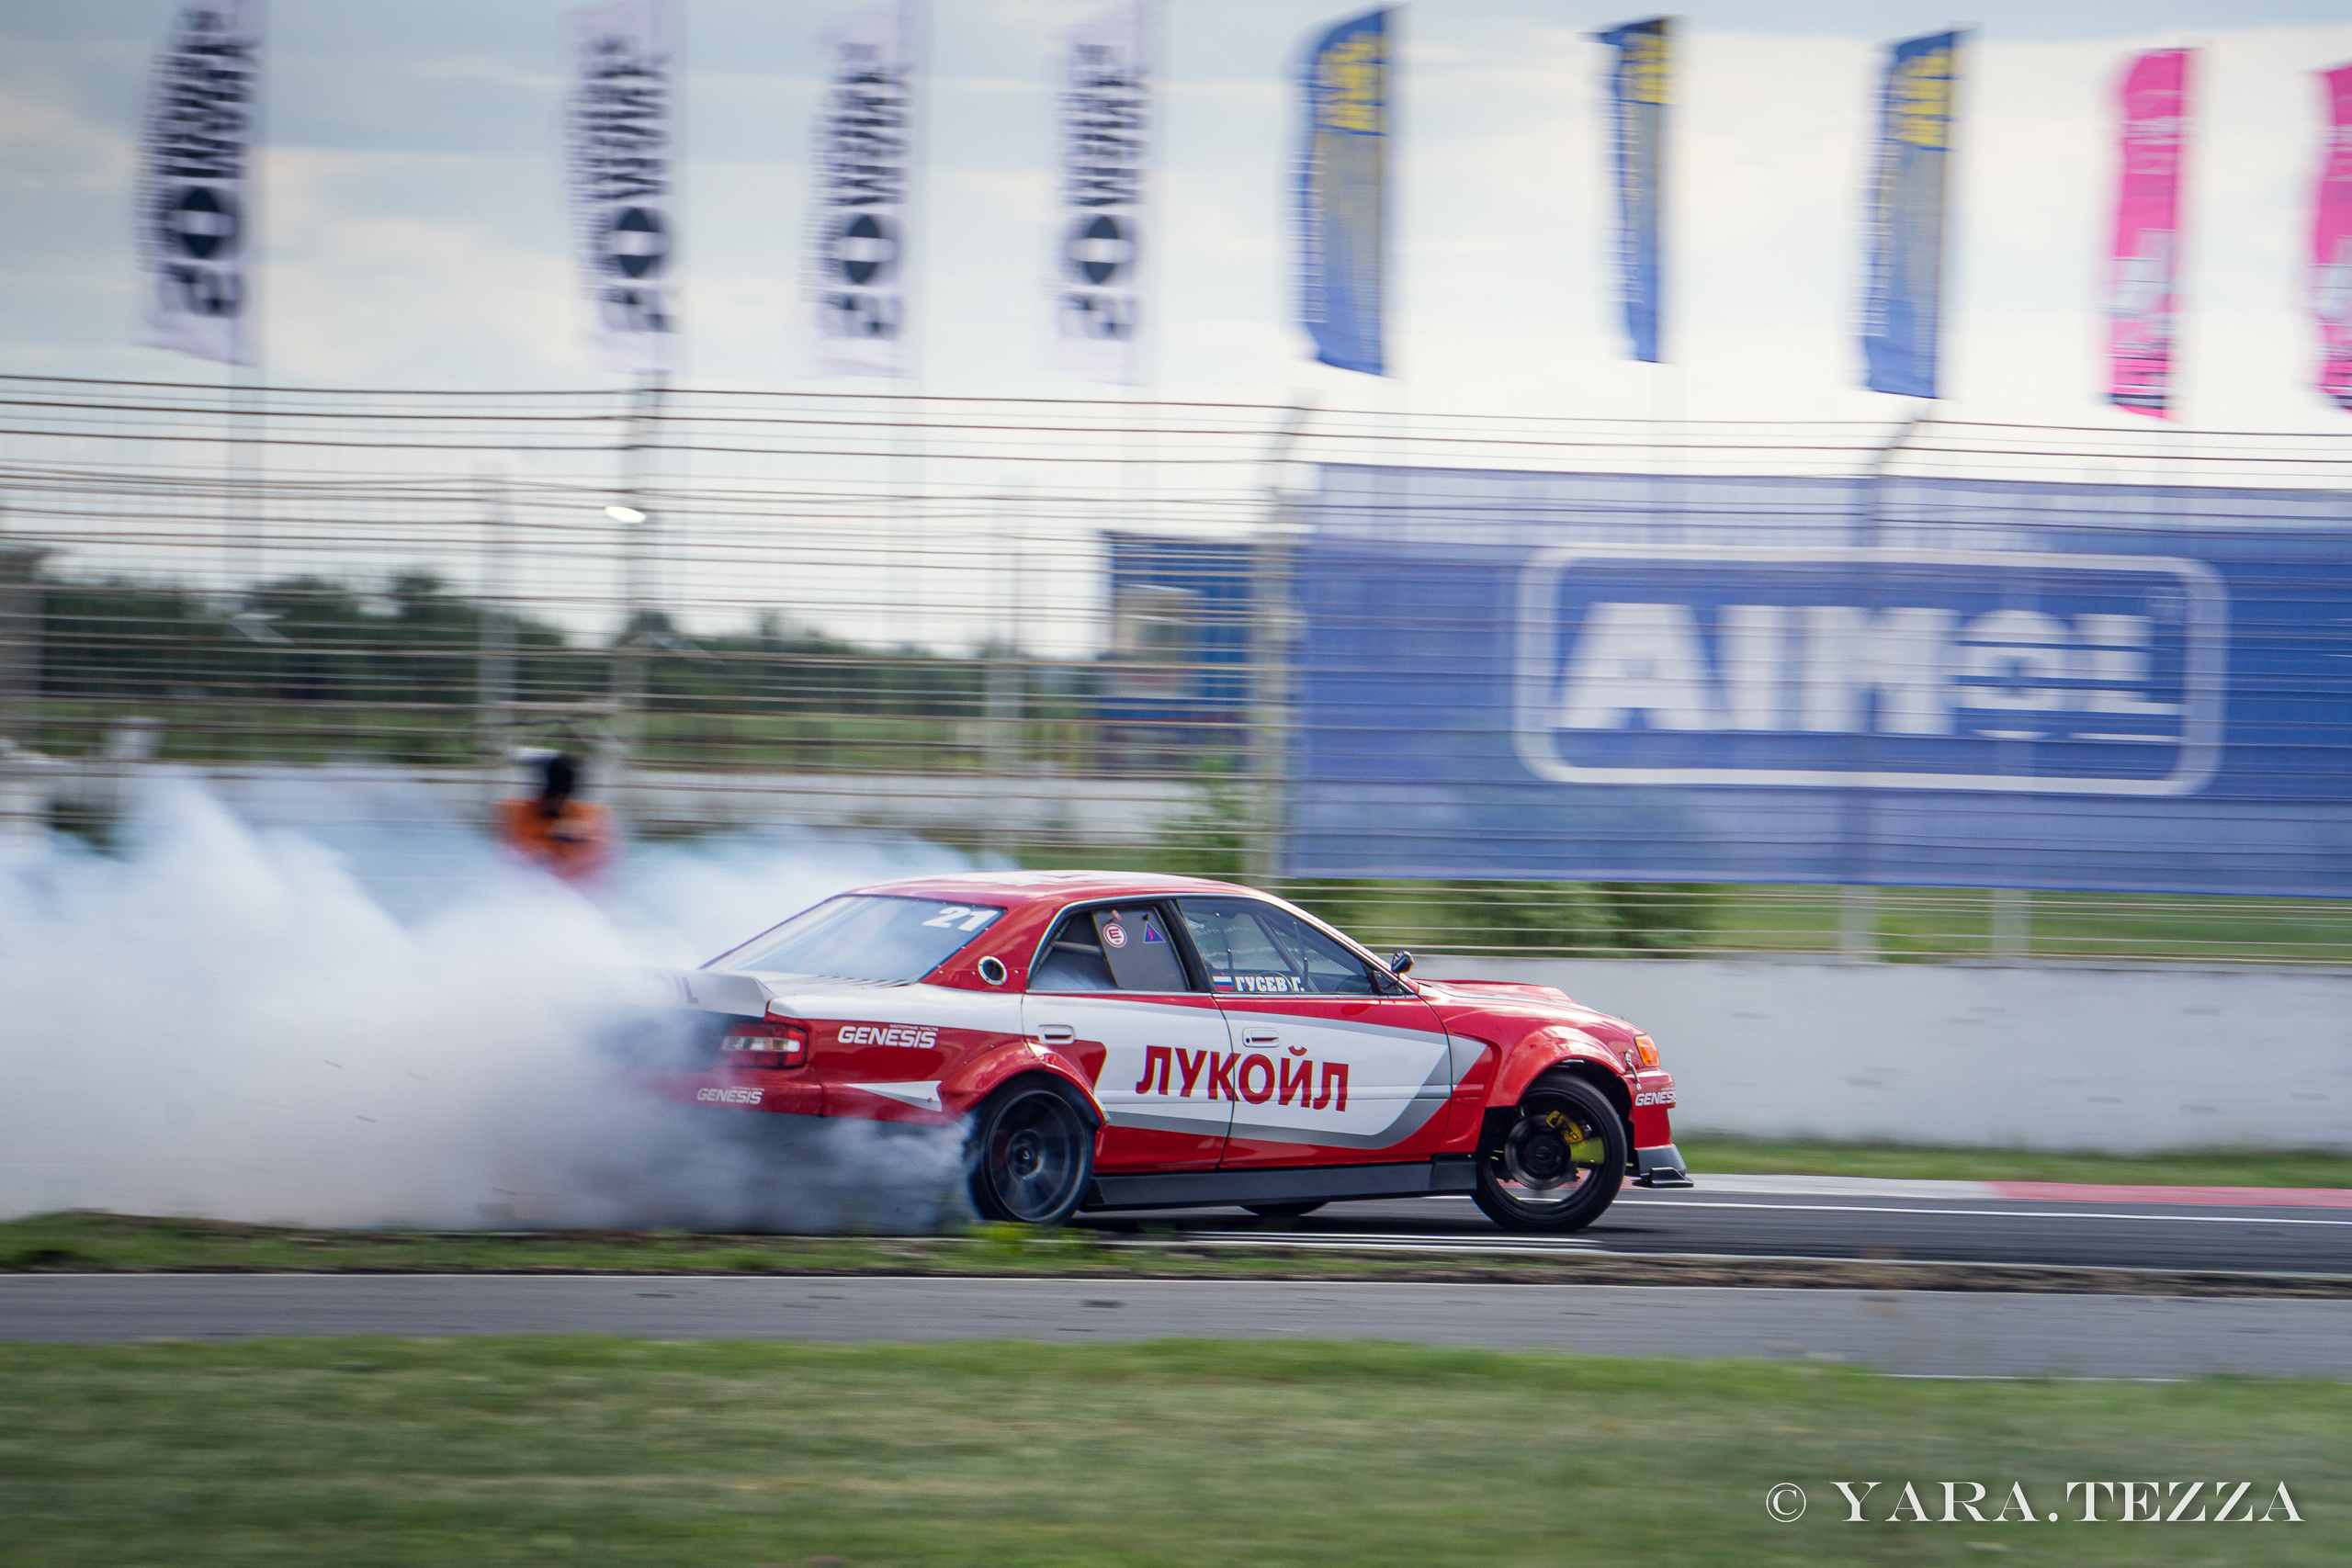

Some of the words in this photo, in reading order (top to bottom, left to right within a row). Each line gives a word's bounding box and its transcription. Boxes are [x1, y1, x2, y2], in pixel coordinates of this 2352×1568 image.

[922, 906, 999, 932] 21
[1234, 976, 1288, 992] ГУСЕВ
[837, 1025, 938, 1050] GENESIS
[1136, 1044, 1350, 1112] ЛУКОЙЛ
[696, 1087, 764, 1105] GENESIS
